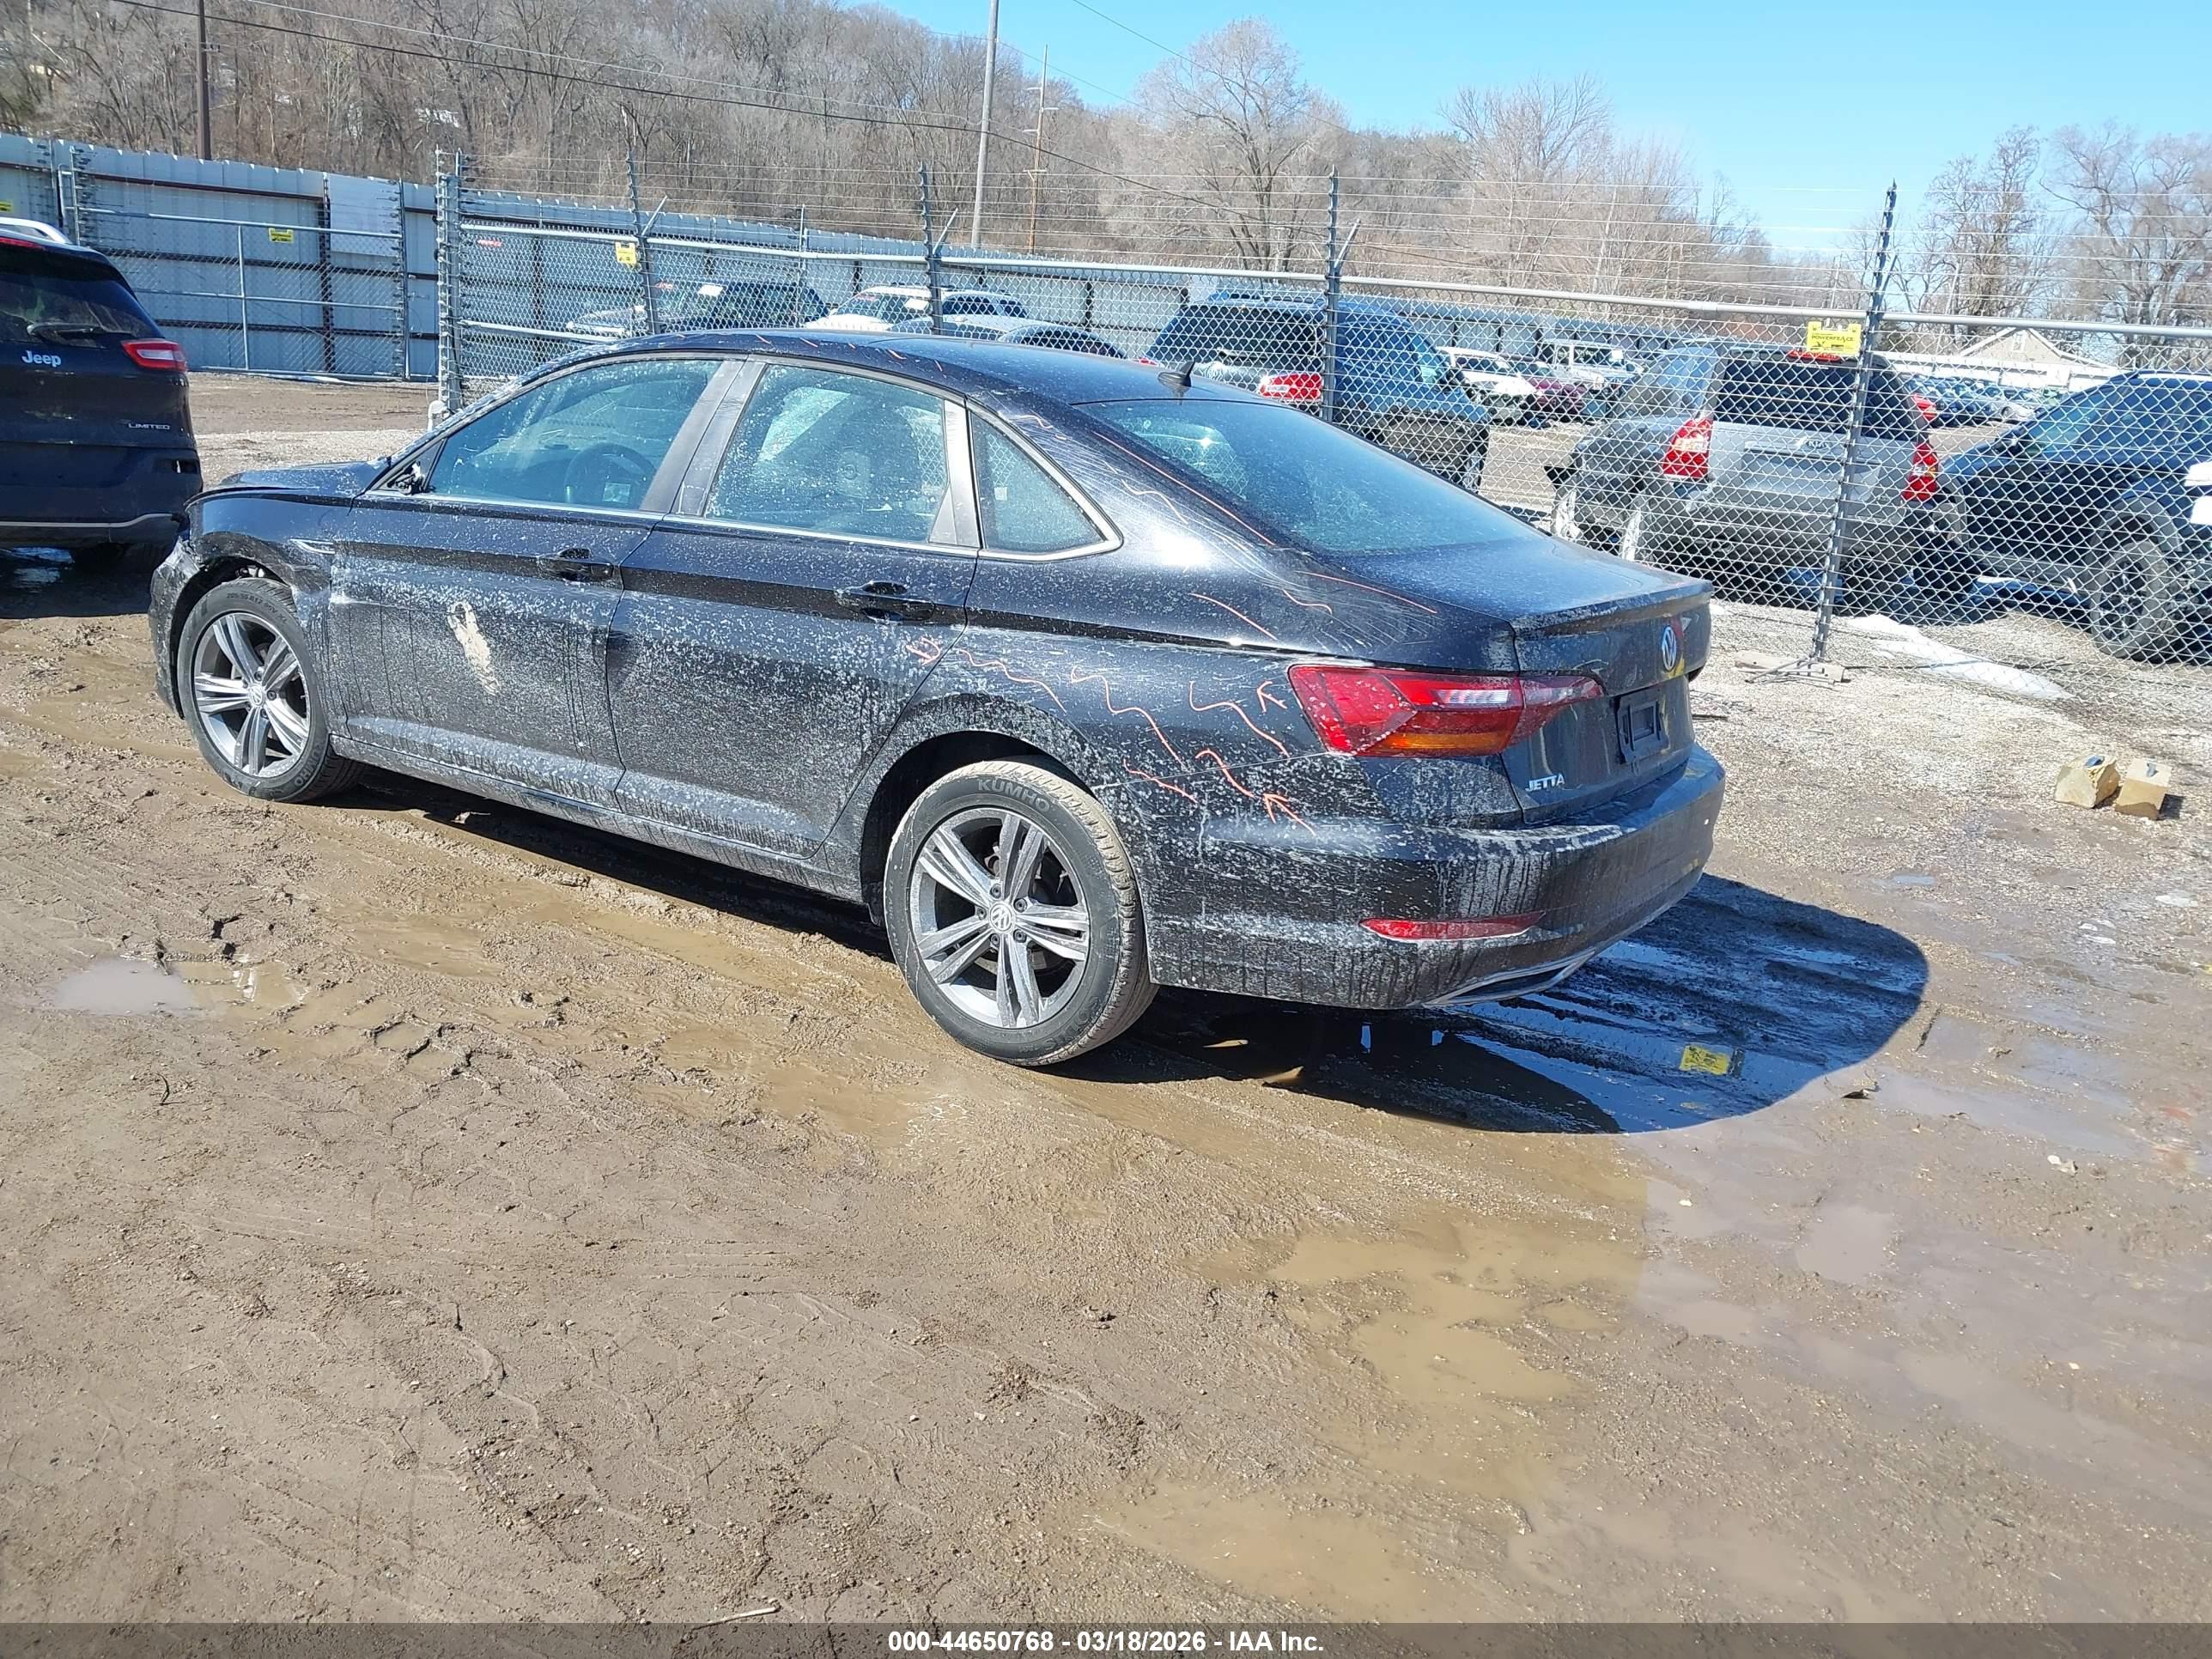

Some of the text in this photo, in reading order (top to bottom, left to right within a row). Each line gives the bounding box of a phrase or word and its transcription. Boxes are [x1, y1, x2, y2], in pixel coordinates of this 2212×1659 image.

[21, 349, 62, 368] Jeep
[1525, 773, 1565, 792] JETTA
[977, 776, 1050, 812] KUMHO
